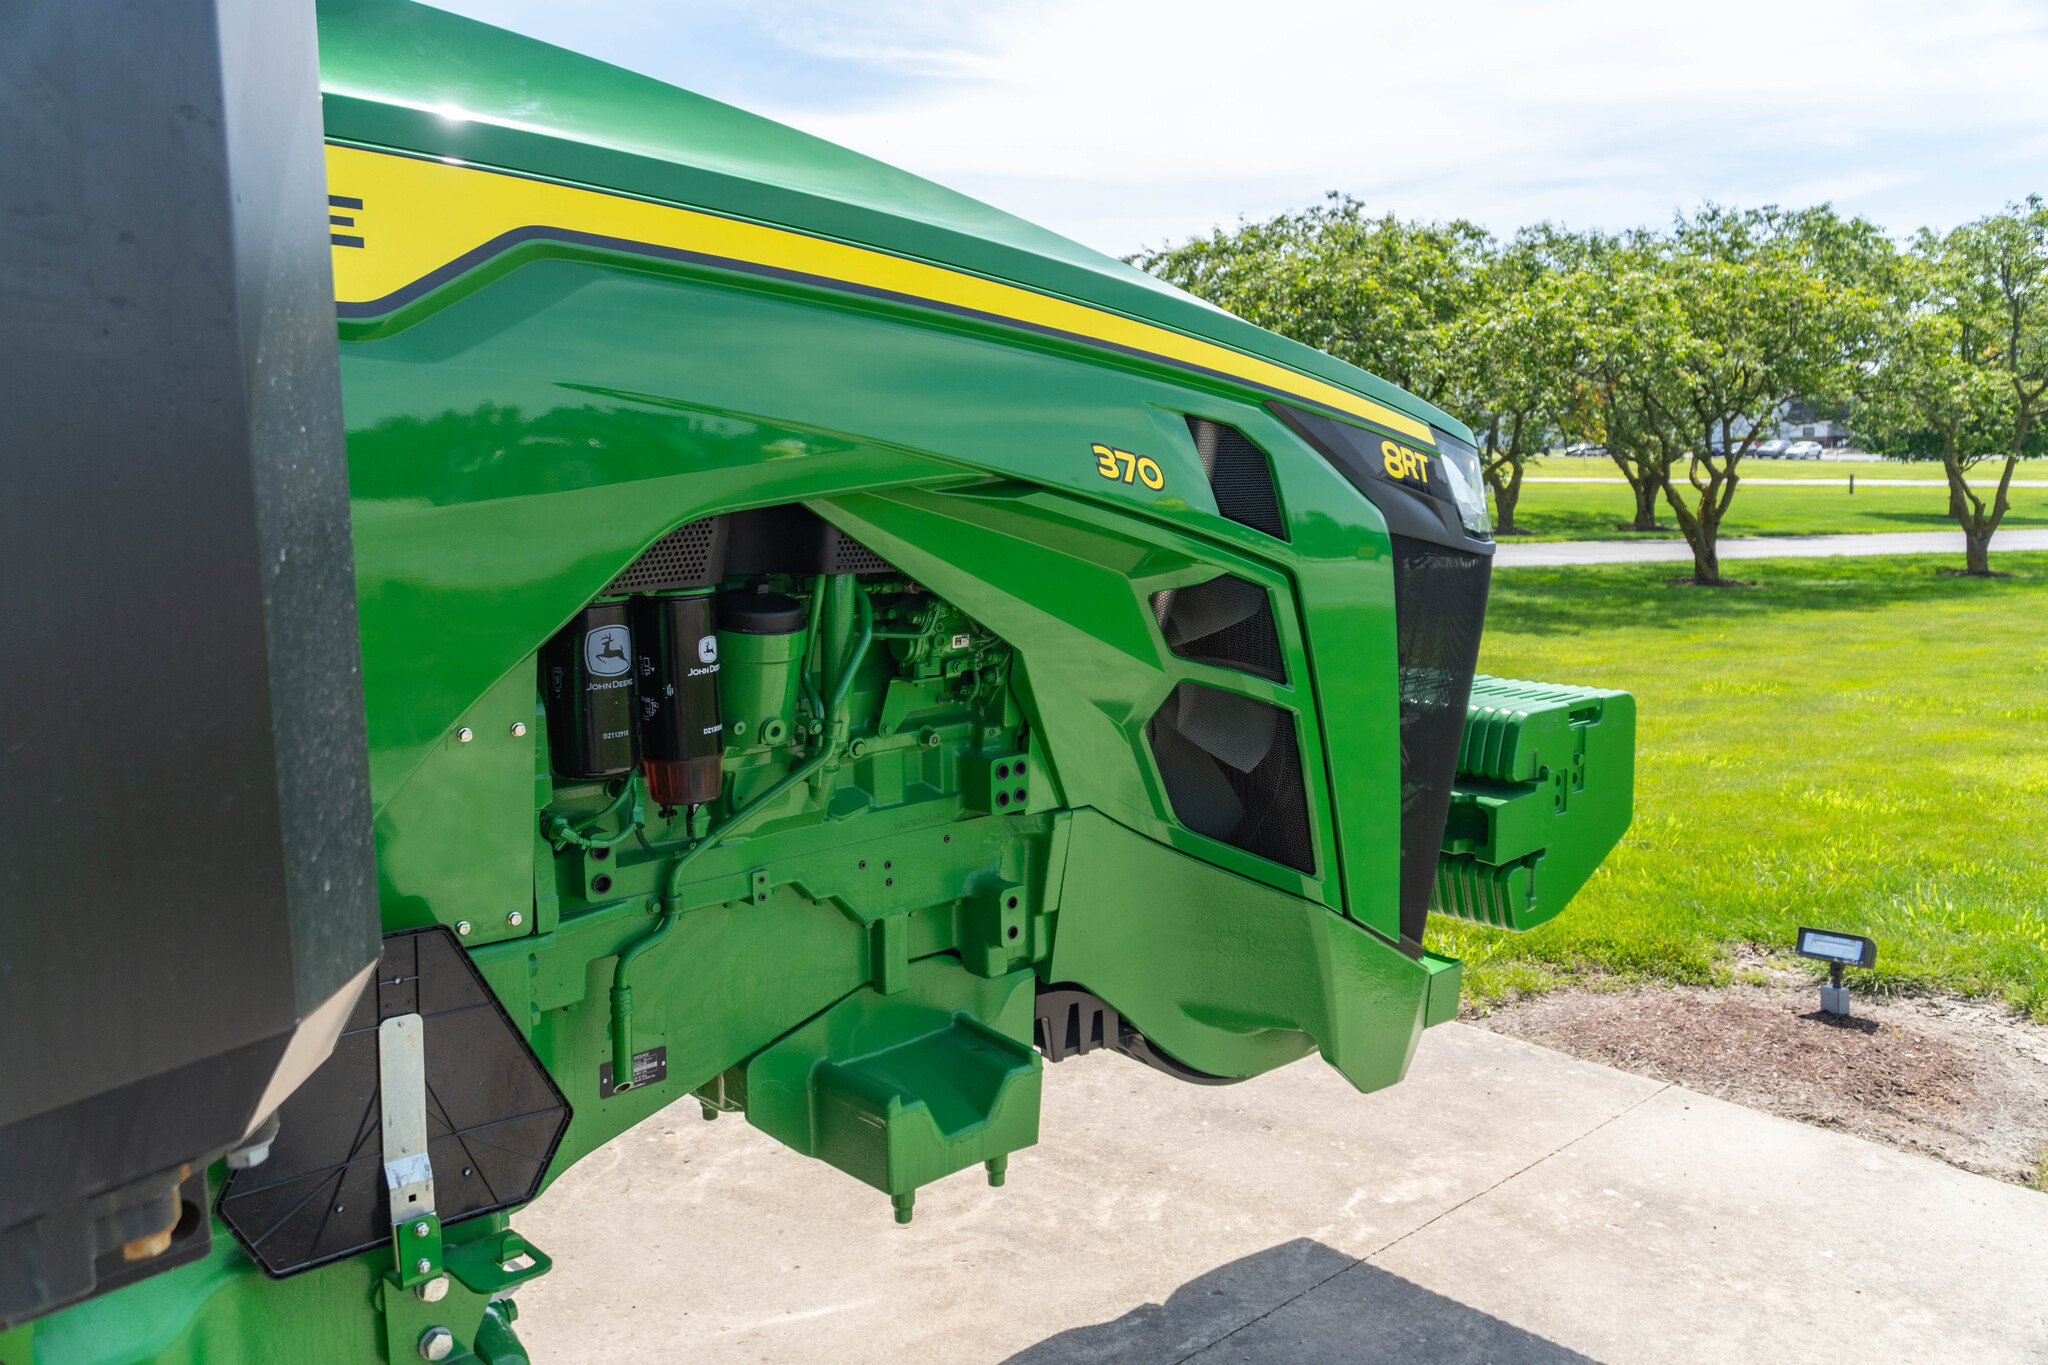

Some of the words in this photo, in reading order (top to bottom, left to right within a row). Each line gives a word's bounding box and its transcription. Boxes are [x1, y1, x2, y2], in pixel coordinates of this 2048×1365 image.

[1090, 442, 1165, 492] 370
[1381, 440, 1428, 483] 8RT
[613, 678, 632, 688] DEERE
[688, 668, 709, 676] JOHN
